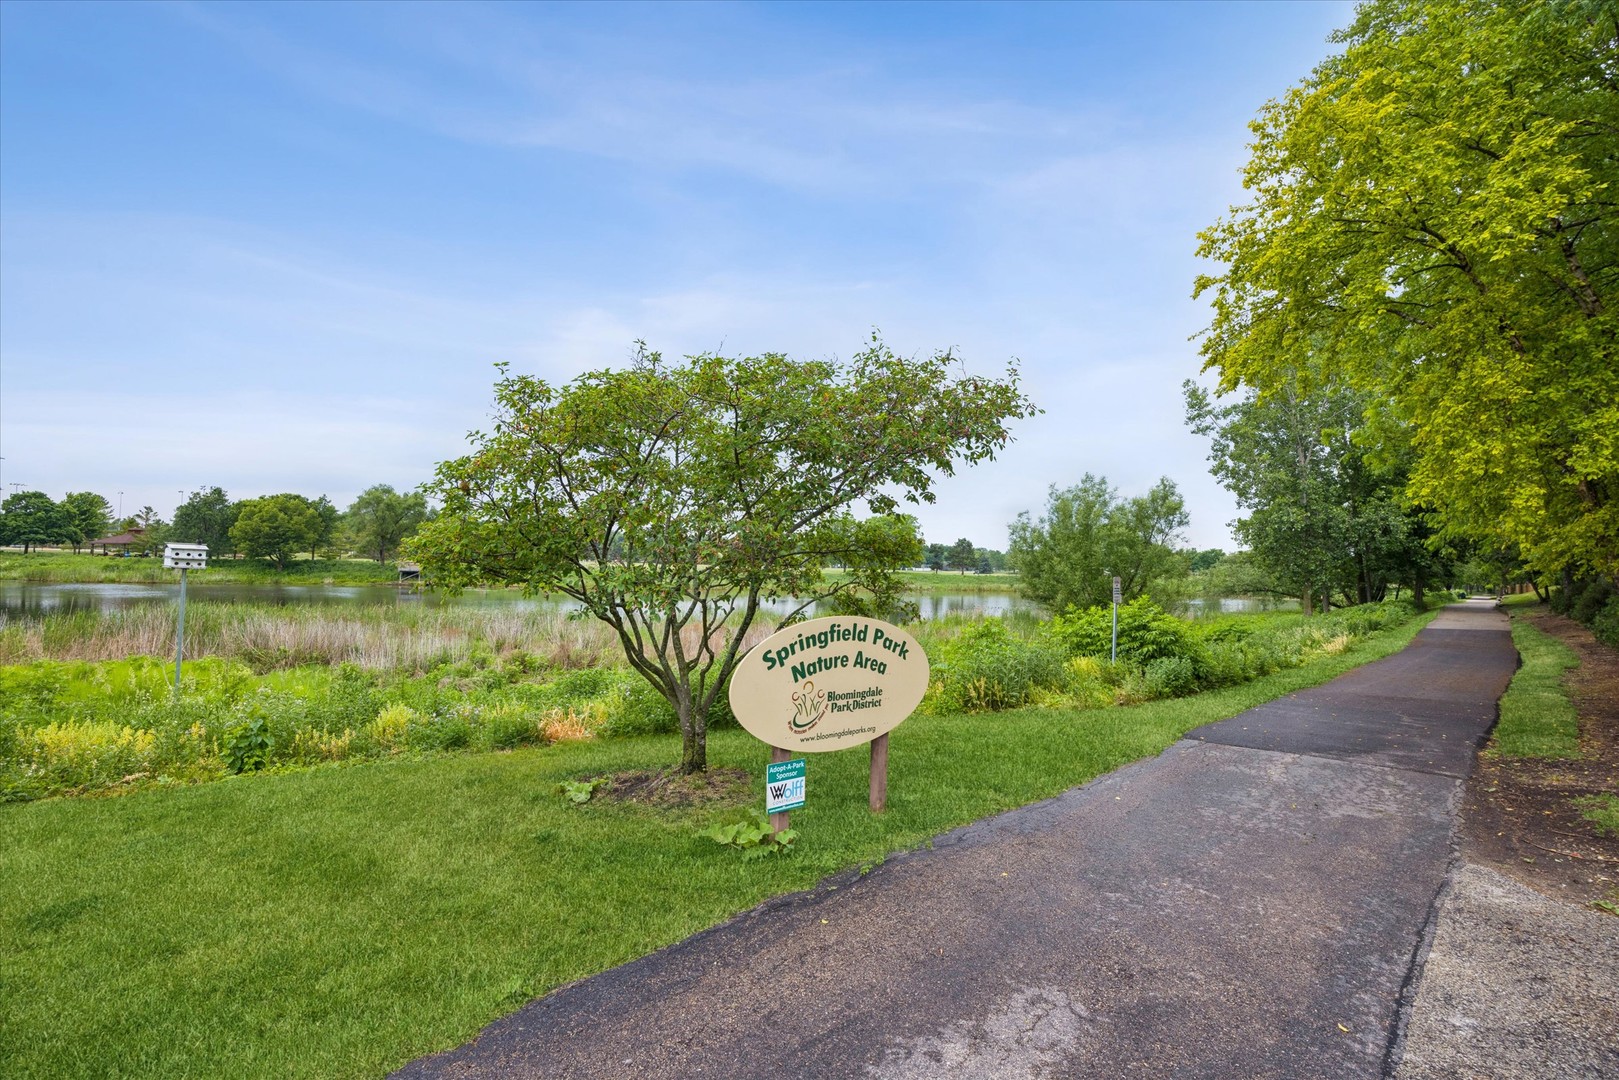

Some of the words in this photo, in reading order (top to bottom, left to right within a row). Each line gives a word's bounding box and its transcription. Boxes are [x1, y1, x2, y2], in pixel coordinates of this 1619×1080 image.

[762, 623, 868, 671] Springfield
[872, 628, 909, 660] Park
[791, 653, 849, 683] Nature
[853, 651, 887, 675] Area
[827, 686, 883, 702] Bloomingdale
[831, 701, 854, 713] Park
[852, 698, 882, 710] District
[800, 726, 876, 743] www.bloomingdaleparks.org
[769, 761, 805, 773] Adopt-A-Park
[776, 771, 798, 780] Sponsor
